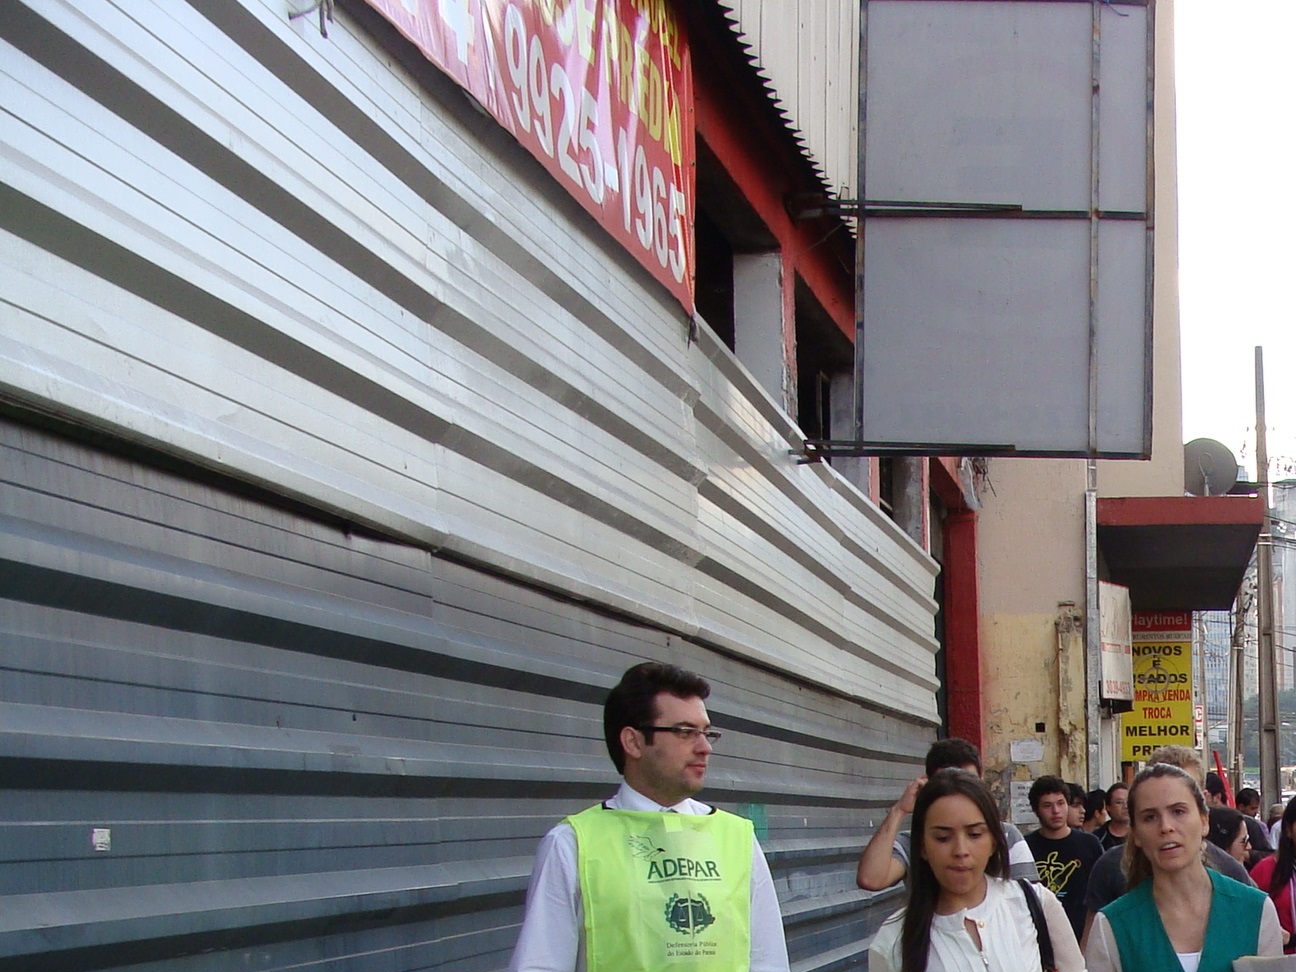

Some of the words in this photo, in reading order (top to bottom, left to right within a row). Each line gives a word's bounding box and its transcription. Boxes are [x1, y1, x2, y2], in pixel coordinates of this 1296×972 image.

[1132, 613, 1188, 628] laytime!
[1132, 646, 1182, 656] NOVOS
[1162, 689, 1191, 701] VENDA
[1142, 707, 1172, 719] TROCA
[1125, 725, 1190, 737] MELHOR
[647, 858, 721, 880] ADEPAR
